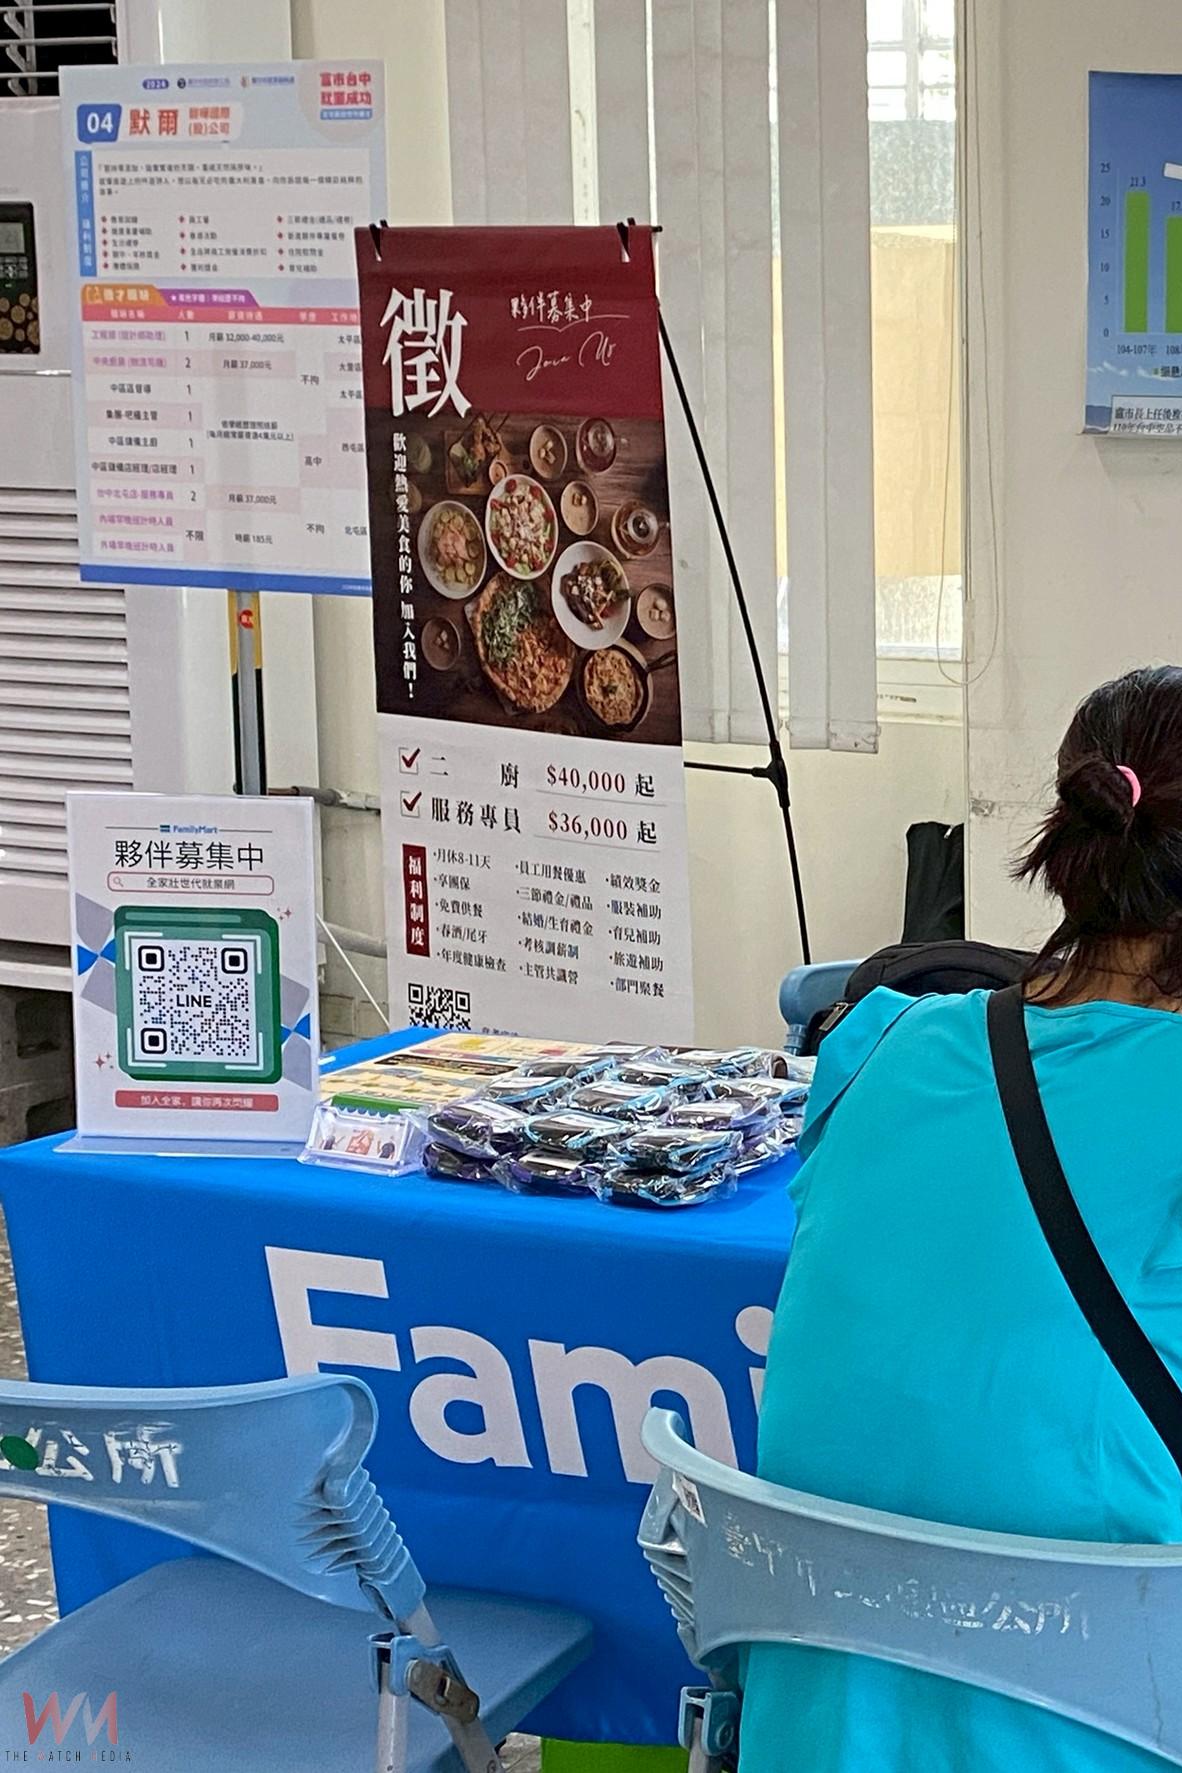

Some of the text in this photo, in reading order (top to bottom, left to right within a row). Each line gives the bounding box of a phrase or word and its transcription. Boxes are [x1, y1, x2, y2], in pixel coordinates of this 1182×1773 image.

[86, 112, 113, 134] 04
[510, 290, 593, 323] 夥伴募集中
[379, 287, 472, 418] 徵
[392, 433, 414, 595] 歡迎熱愛美食的你
[547, 763, 625, 794] $40,000
[635, 773, 655, 798] 起
[173, 825, 218, 835] FamilyMart
[431, 797, 657, 845] 服務專員 $36,000 起
[115, 840, 264, 871] 夥伴募集中
[437, 848, 491, 870] 月休8-11天
[520, 860, 587, 884] 員工用餐優惠
[610, 873, 661, 894] 績效獎金
[408, 856, 425, 947] 福利制度
[519, 886, 593, 911] 三節禮金/禮品
[611, 899, 662, 920] 服裝補助
[522, 911, 594, 937] 結婚/生育禮金
[613, 925, 661, 946] 育兒補助
[441, 948, 507, 972] 年度健康檢查
[614, 951, 664, 972] 旅遊補助
[523, 962, 579, 985] 主管共識營
[615, 977, 665, 998] 部門聚餐
[176, 994, 213, 1008] LINE
